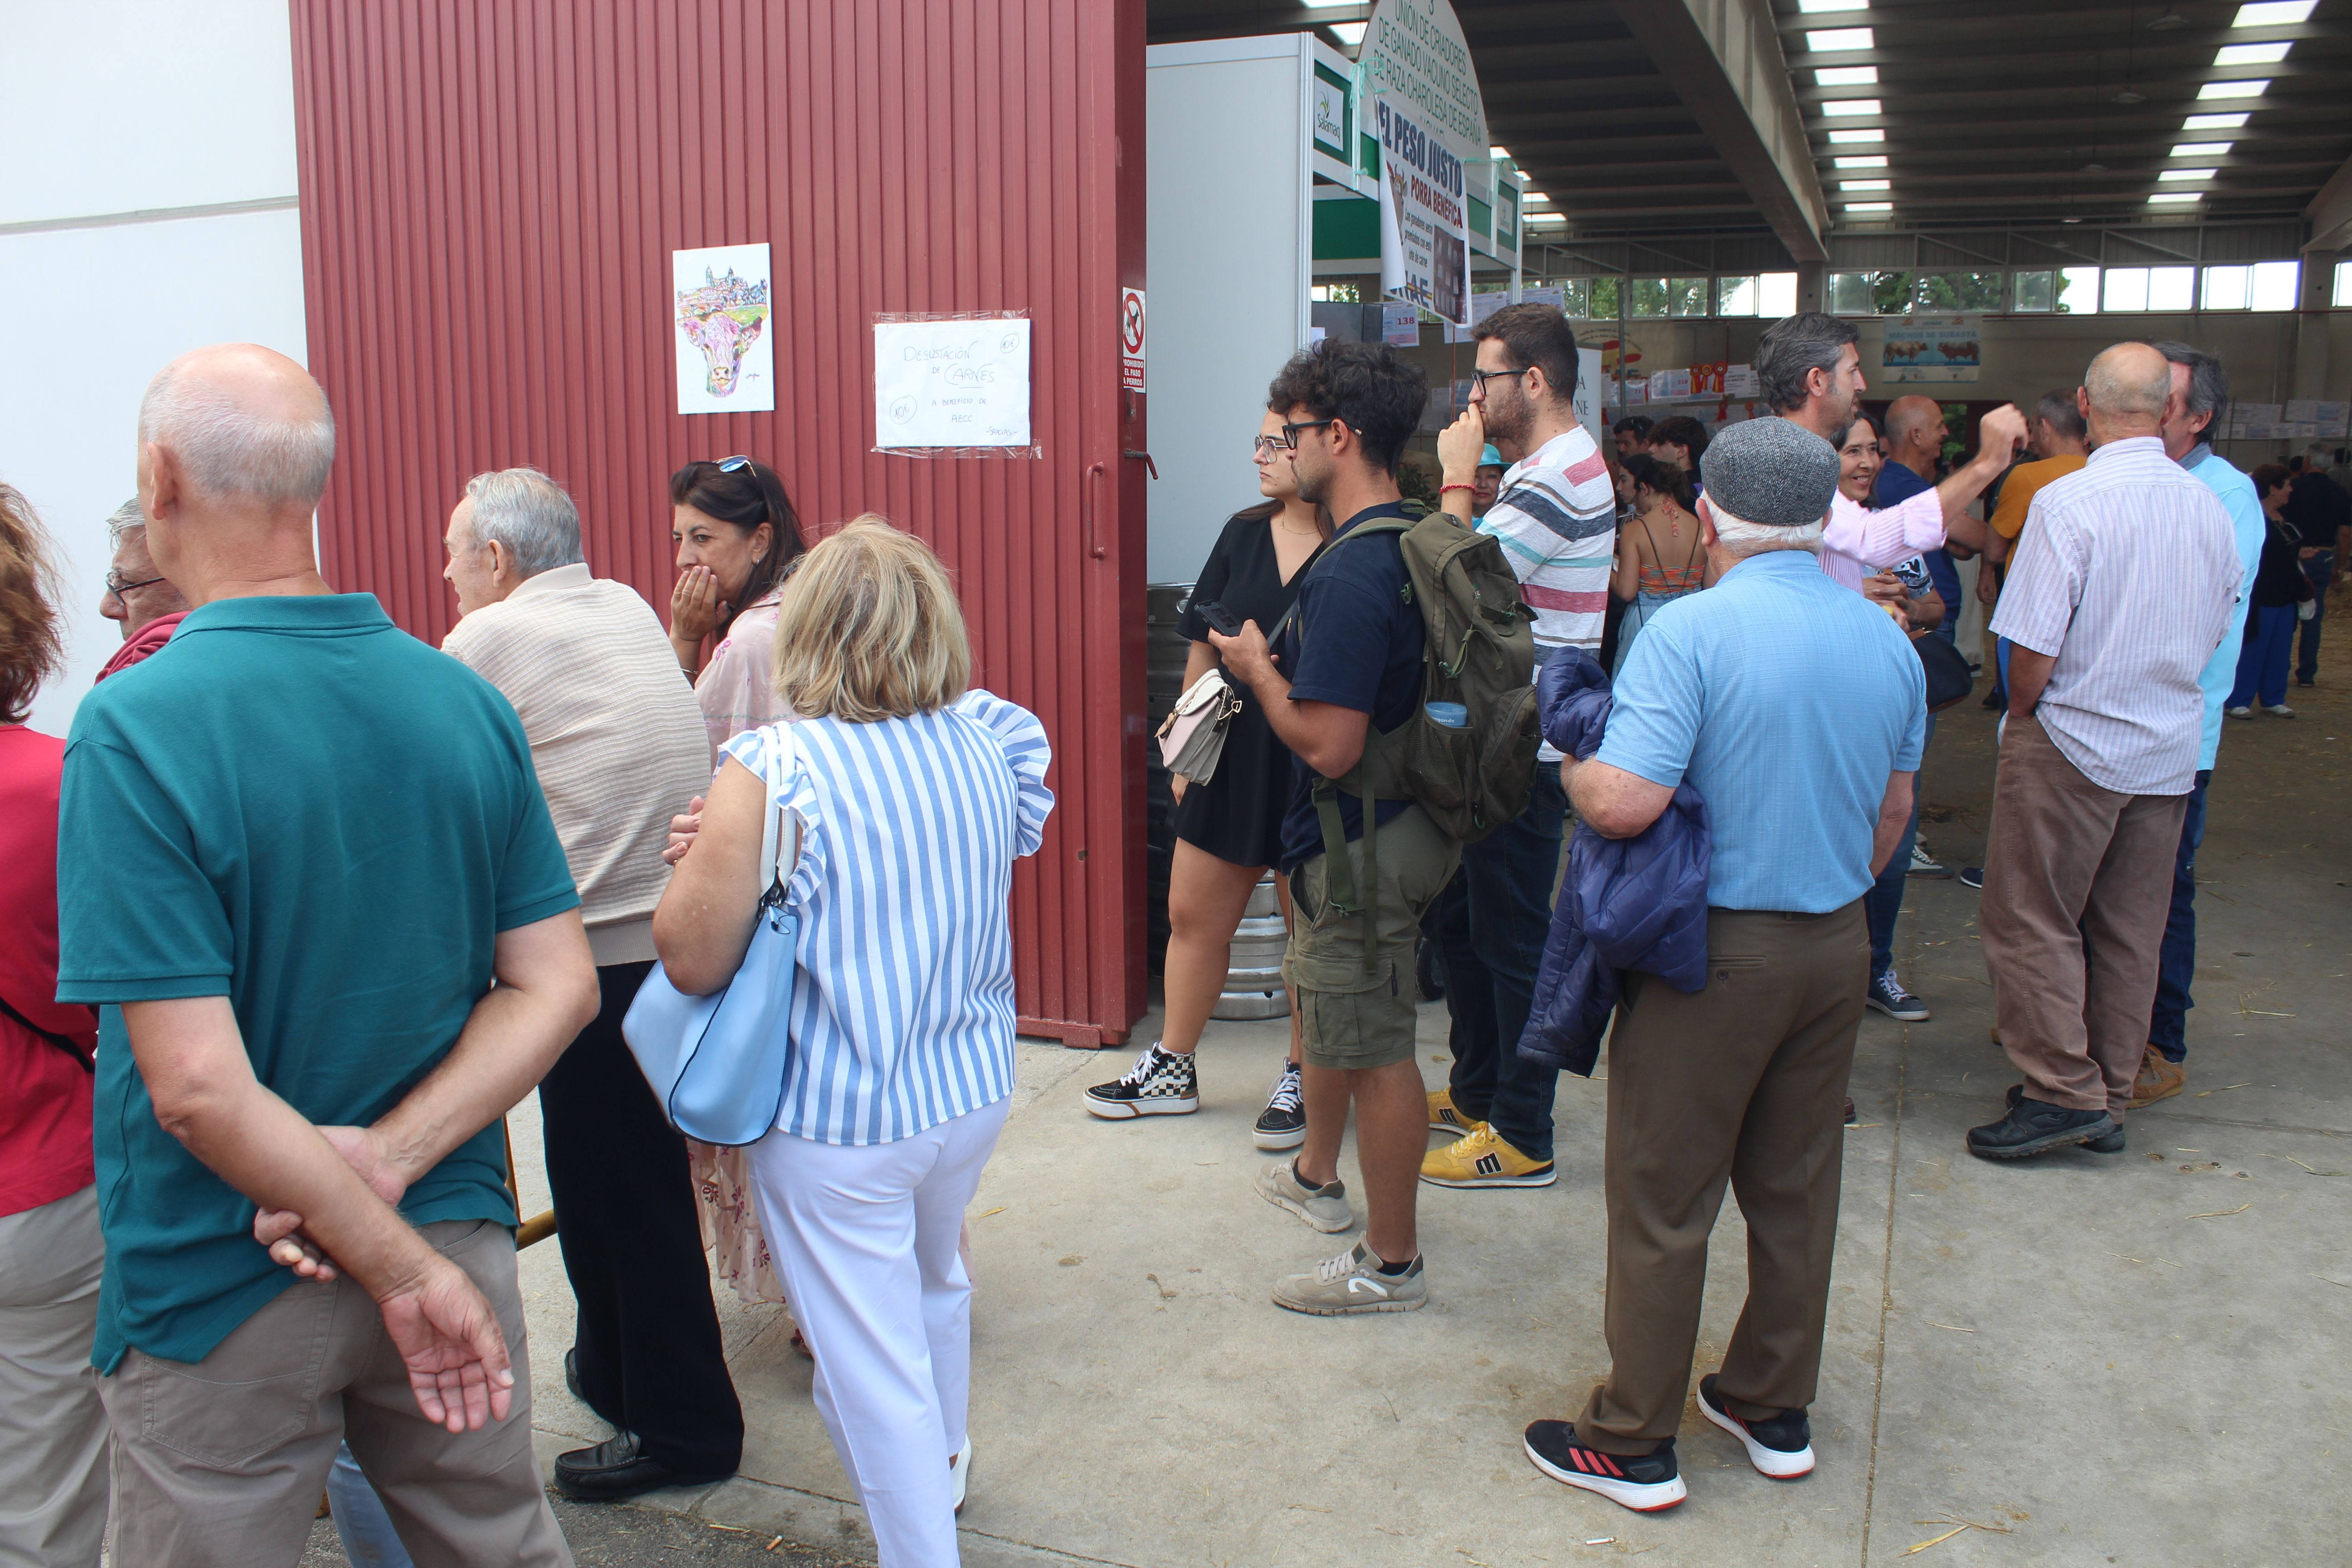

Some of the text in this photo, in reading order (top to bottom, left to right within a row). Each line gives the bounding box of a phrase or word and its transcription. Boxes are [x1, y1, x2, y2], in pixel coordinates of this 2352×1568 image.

[1395, 0, 1466, 76] UNIÓN DE CRIADORES
[1379, 16, 1478, 115] DE GANADO VACUNO SELECTO
[1374, 49, 1385, 81] DE
[1387, 58, 1406, 96] RAZA
[1407, 73, 1448, 125] CHAROLESA
[1449, 104, 1457, 132] DE
[1458, 111, 1481, 148] ESPAÑA
[1318, 113, 1341, 143] Salamaq
[1394, 112, 1426, 172] PESO
[1427, 139, 1462, 198] JUSTO
[1411, 174, 1463, 229] PORRA BENÉFICA
[1411, 213, 1425, 231] ganadores
[1405, 229, 1420, 246] premiados
[1397, 317, 1415, 325] 138
[904, 340, 979, 361] DEGUSTACIÓN
[1002, 339, 1015, 350] 10€
[944, 363, 995, 385] CARNES
[1127, 377, 1142, 386] PERROS
[1130, 368, 1141, 377] PASO
[951, 415, 973, 423] AECC
